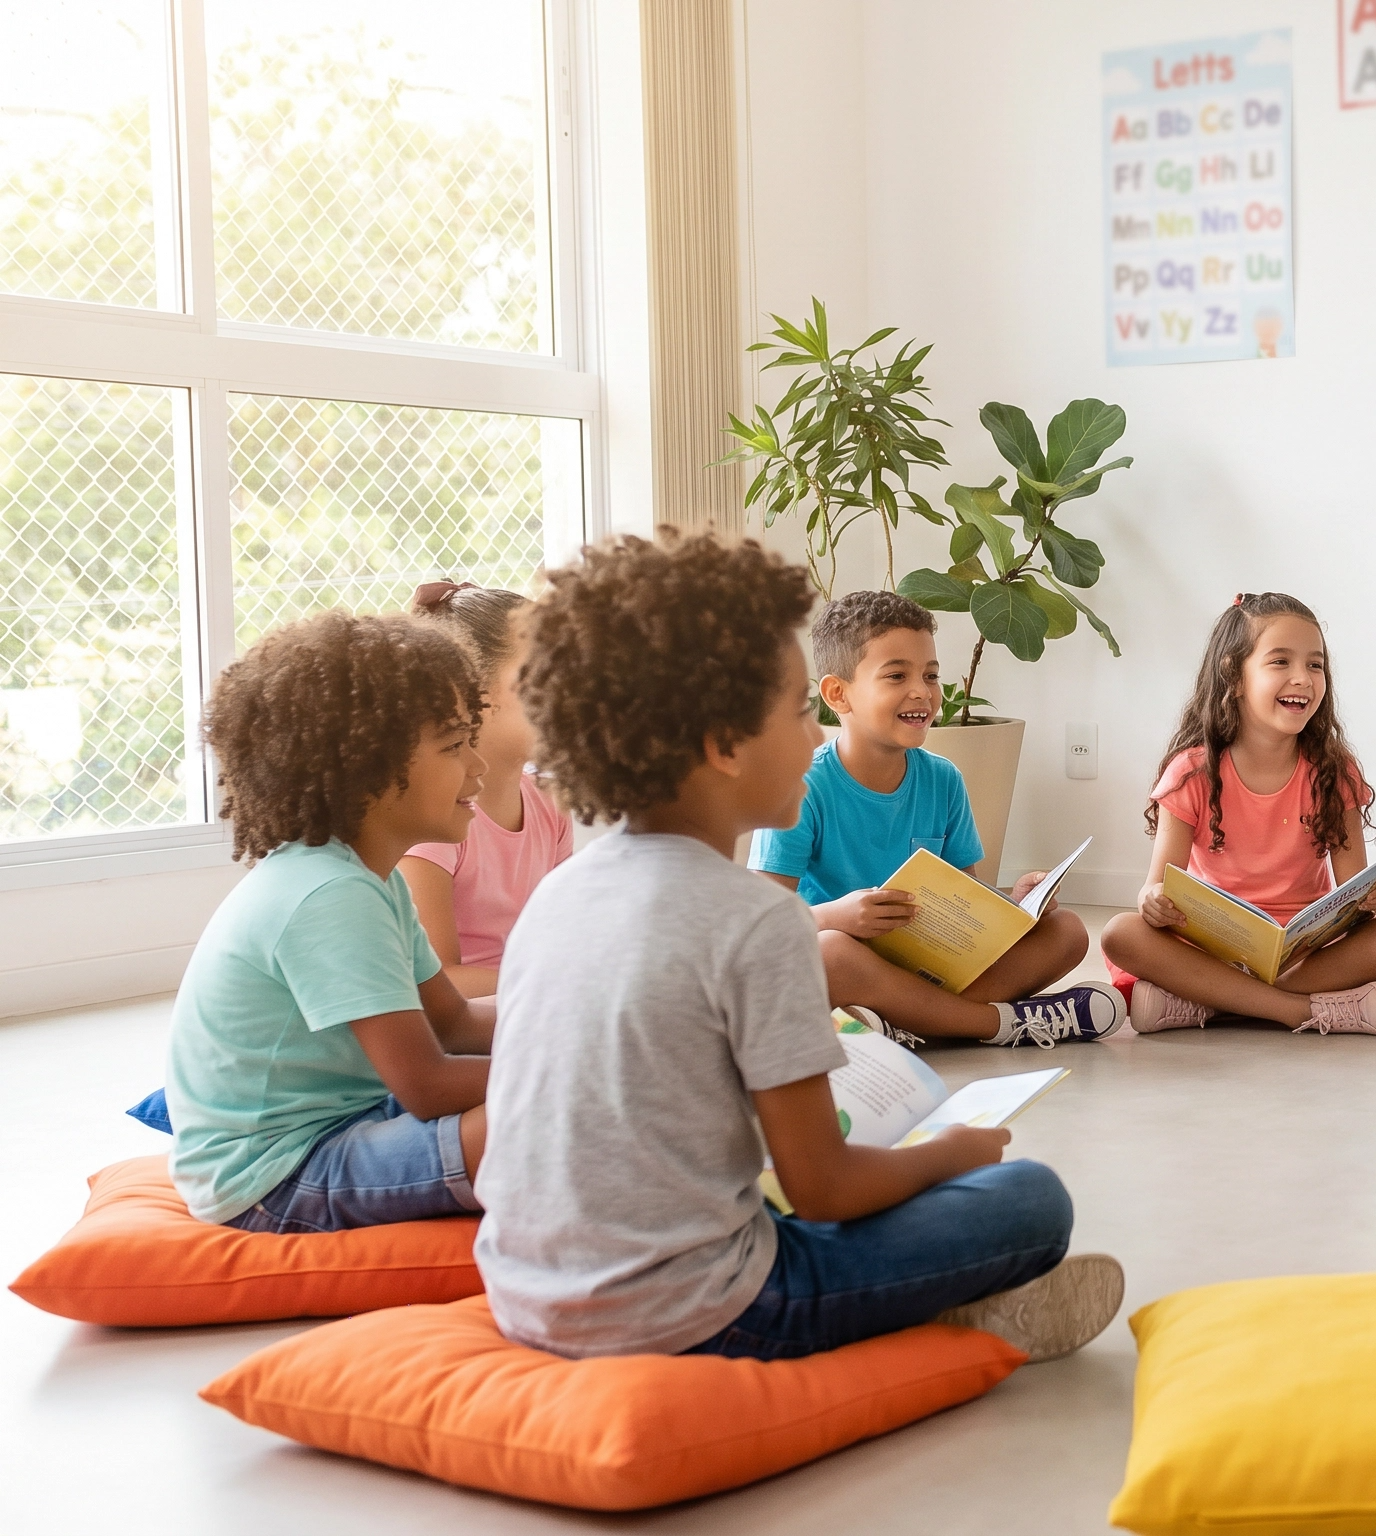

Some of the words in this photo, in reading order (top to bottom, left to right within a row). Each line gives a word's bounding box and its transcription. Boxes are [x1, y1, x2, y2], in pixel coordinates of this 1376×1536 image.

[1113, 117, 1146, 142] Aa
[1157, 110, 1191, 138] Bb
[1199, 104, 1234, 134] Cc
[1114, 163, 1142, 191] Ff
[1154, 160, 1192, 194] Gg
[1200, 156, 1237, 183] Hh
[1201, 209, 1237, 233] Nn
[1244, 202, 1283, 232] Oo
[1114, 264, 1149, 295] Pp
[1156, 260, 1194, 291] Qq
[1202, 256, 1234, 284] Rr
[1246, 254, 1283, 282] Uu
[1115, 315, 1149, 340] Vv
[1161, 312, 1192, 343] Yy
[1205, 306, 1236, 335] Zz
